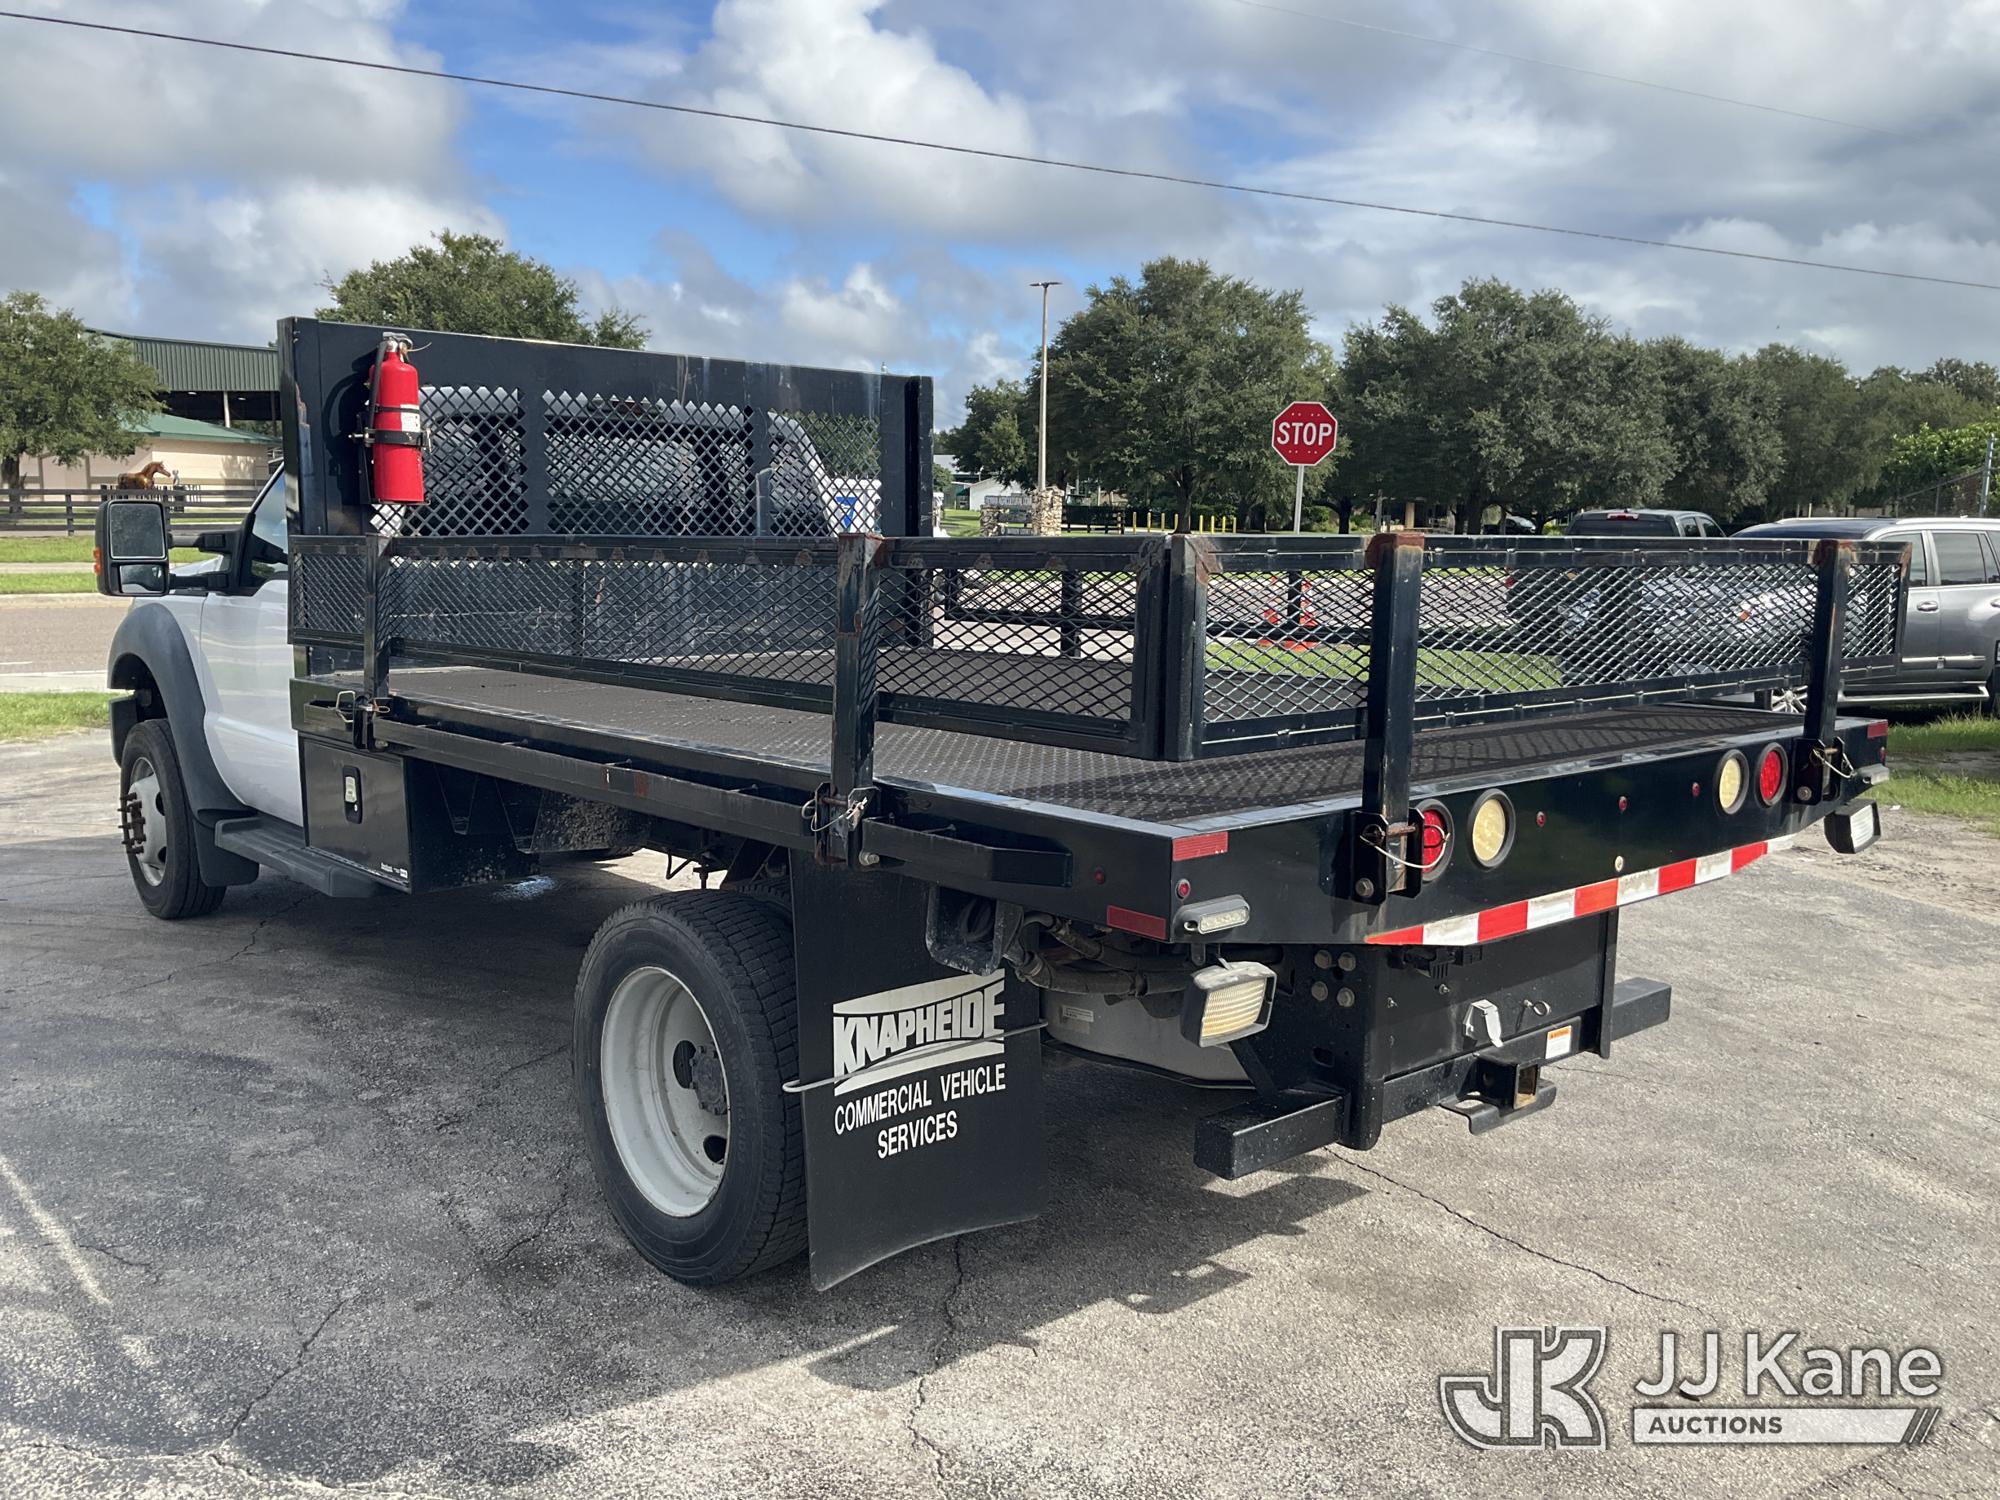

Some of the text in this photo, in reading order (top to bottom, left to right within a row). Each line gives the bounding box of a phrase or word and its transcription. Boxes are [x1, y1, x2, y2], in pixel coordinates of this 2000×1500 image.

[1276, 421, 1333, 446] STOP
[833, 979, 1005, 1083] KNAPHEIDE
[834, 1063, 1006, 1135] COMMERCIAL VEHICLE
[877, 1110, 958, 1159] SERVICES
